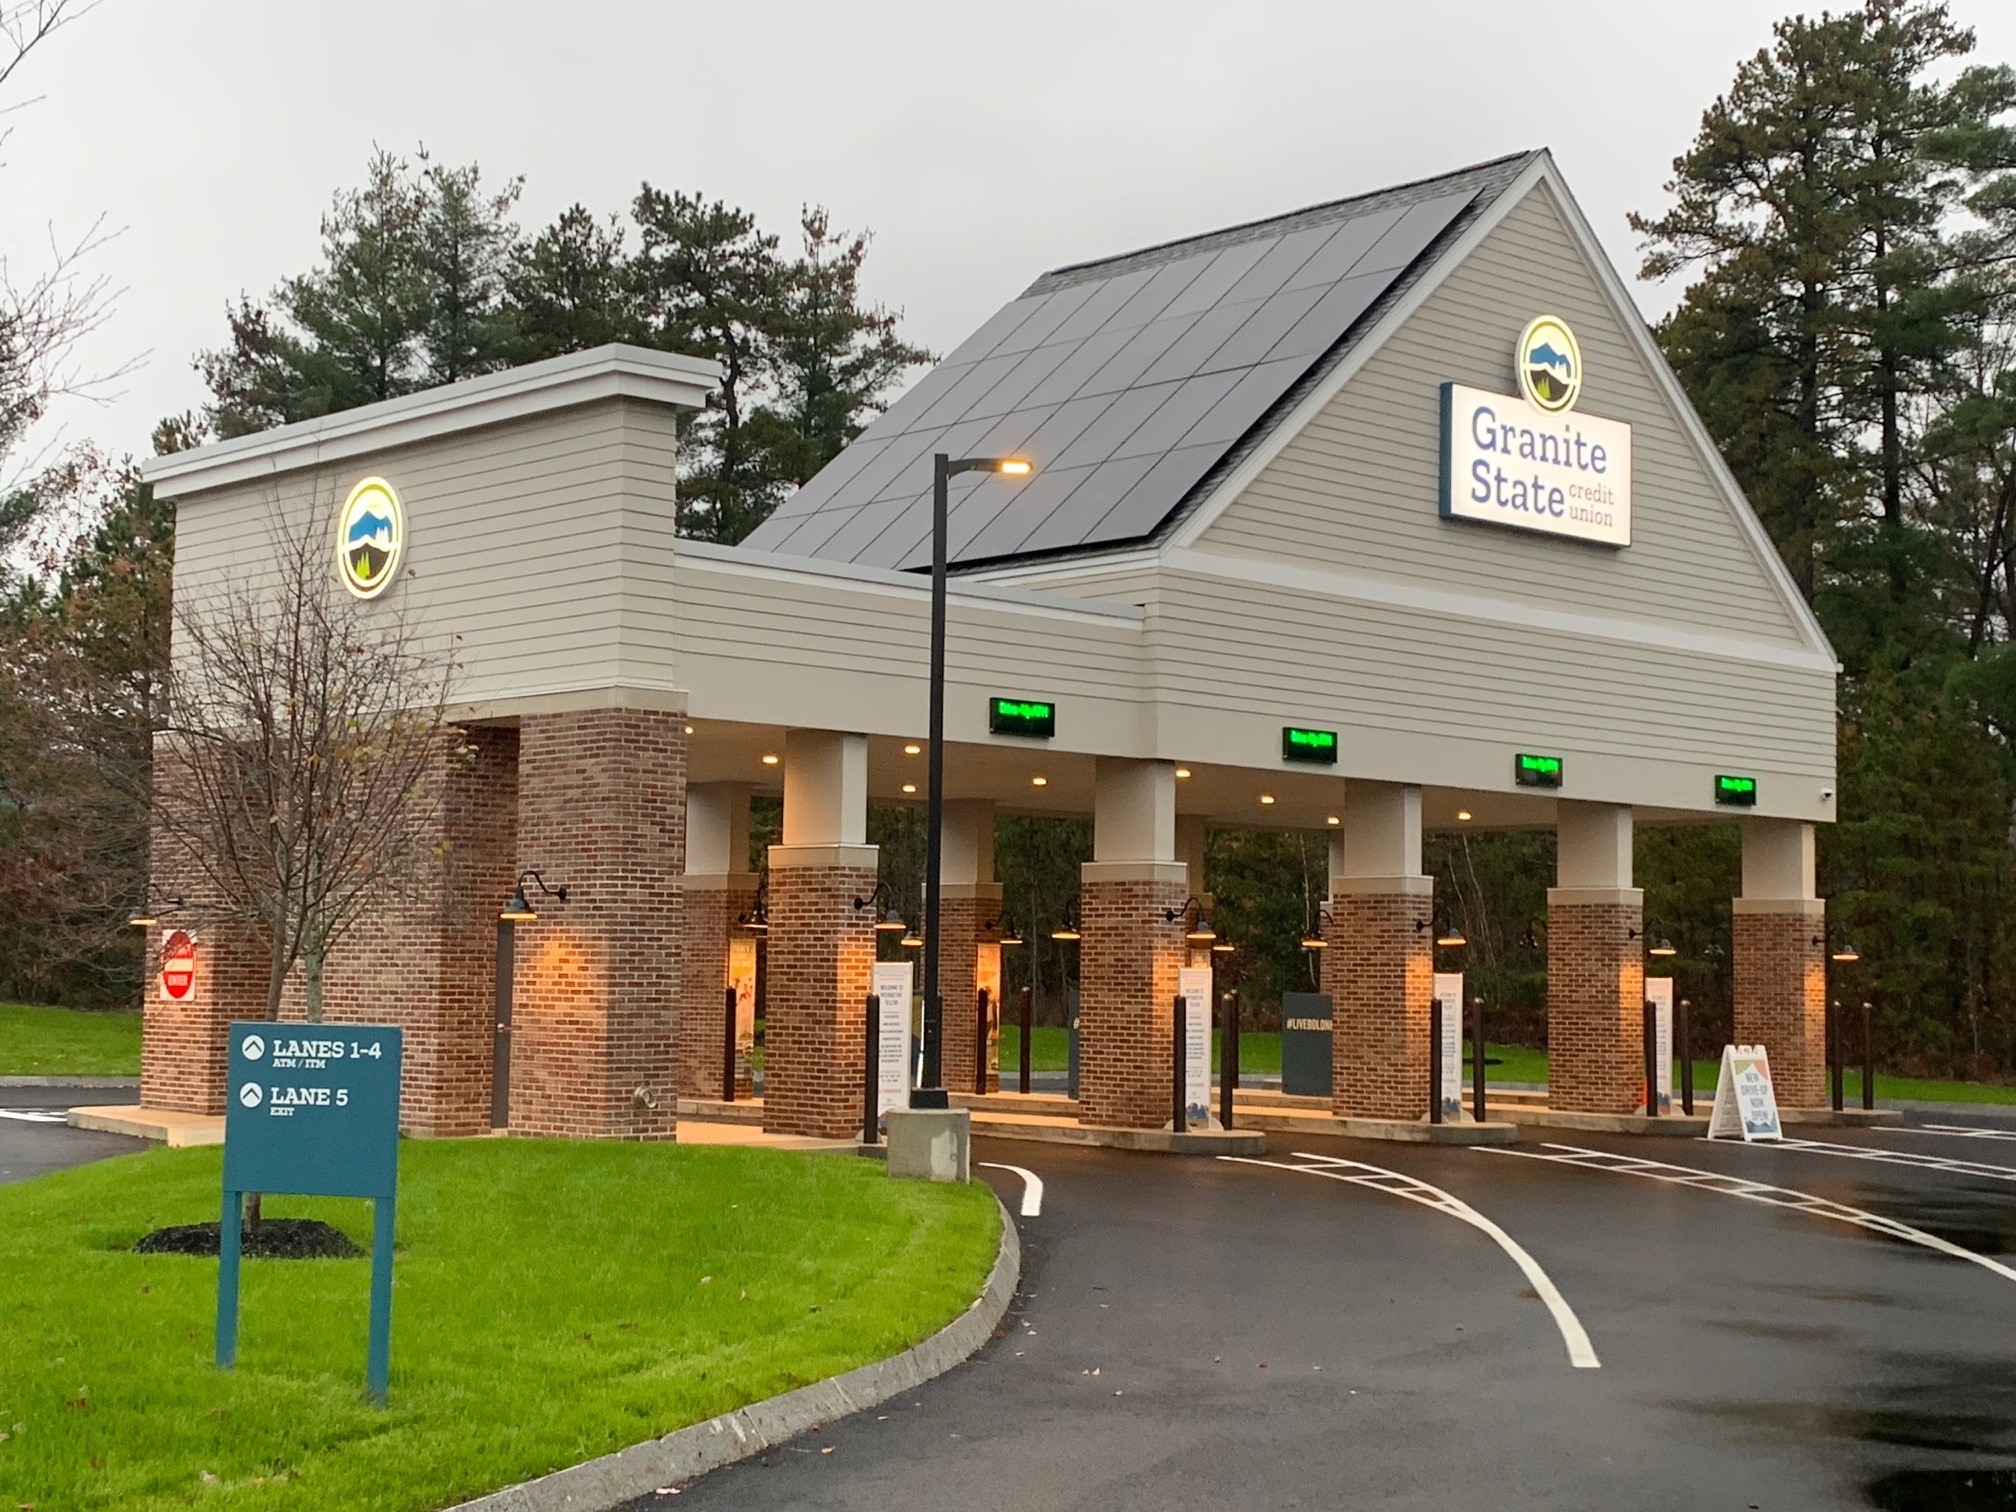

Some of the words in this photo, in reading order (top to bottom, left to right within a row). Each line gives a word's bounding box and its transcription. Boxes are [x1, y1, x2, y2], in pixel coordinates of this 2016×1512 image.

[1472, 406, 1607, 474] Granite
[1471, 459, 1565, 518] State
[1569, 483, 1615, 506] credit
[1569, 504, 1613, 527] union
[272, 1040, 344, 1058] LANES
[350, 1042, 382, 1059] 1-4
[272, 1058, 296, 1068] ATM
[305, 1059, 326, 1069] ITM
[270, 1087, 330, 1106] LANE
[335, 1089, 349, 1106] 5
[270, 1107, 295, 1116] EXIT
